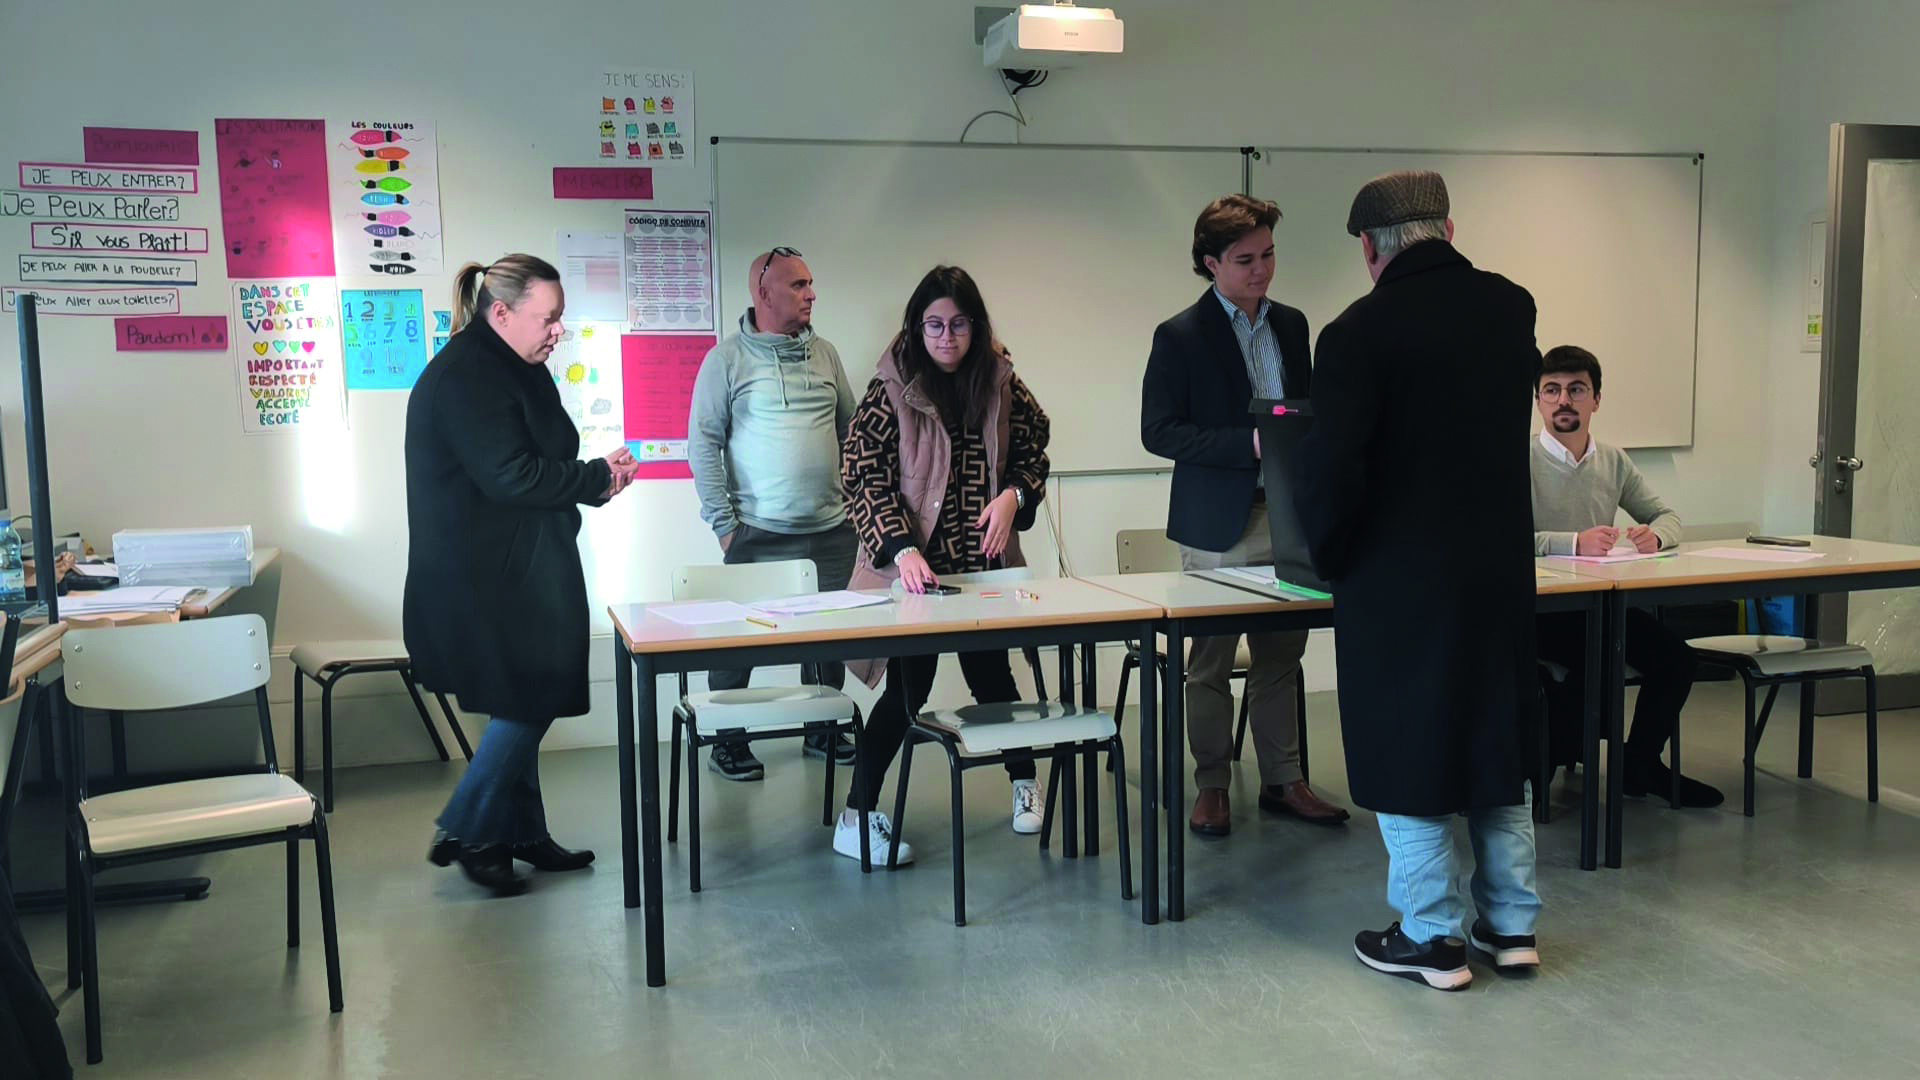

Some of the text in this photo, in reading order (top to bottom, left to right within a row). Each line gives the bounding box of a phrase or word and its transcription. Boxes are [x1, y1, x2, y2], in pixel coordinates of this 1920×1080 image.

[603, 72, 619, 87] JE
[624, 73, 639, 88] ME
[351, 121, 414, 130] LES COULEURS
[32, 169, 185, 189] JE PEUX ENTRER?
[4, 193, 179, 220] Je Peux Parler?
[629, 217, 657, 225] CÓDIGO
[51, 223, 82, 248] S'il
[22, 262, 38, 273] JE
[42, 262, 67, 273] PEUX
[114, 265, 124, 275] LA
[240, 283, 310, 301] DANS CET
[65, 296, 91, 307] Aller
[98, 297, 121, 305] aux
[242, 300, 304, 319] ESPACE
[345, 302, 353, 318] 1
[361, 300, 375, 318] 2
[246, 318, 293, 334] VOUS
[383, 321, 397, 339] 7
[405, 319, 418, 338] 8
[248, 358, 324, 373] IMPORTANT
